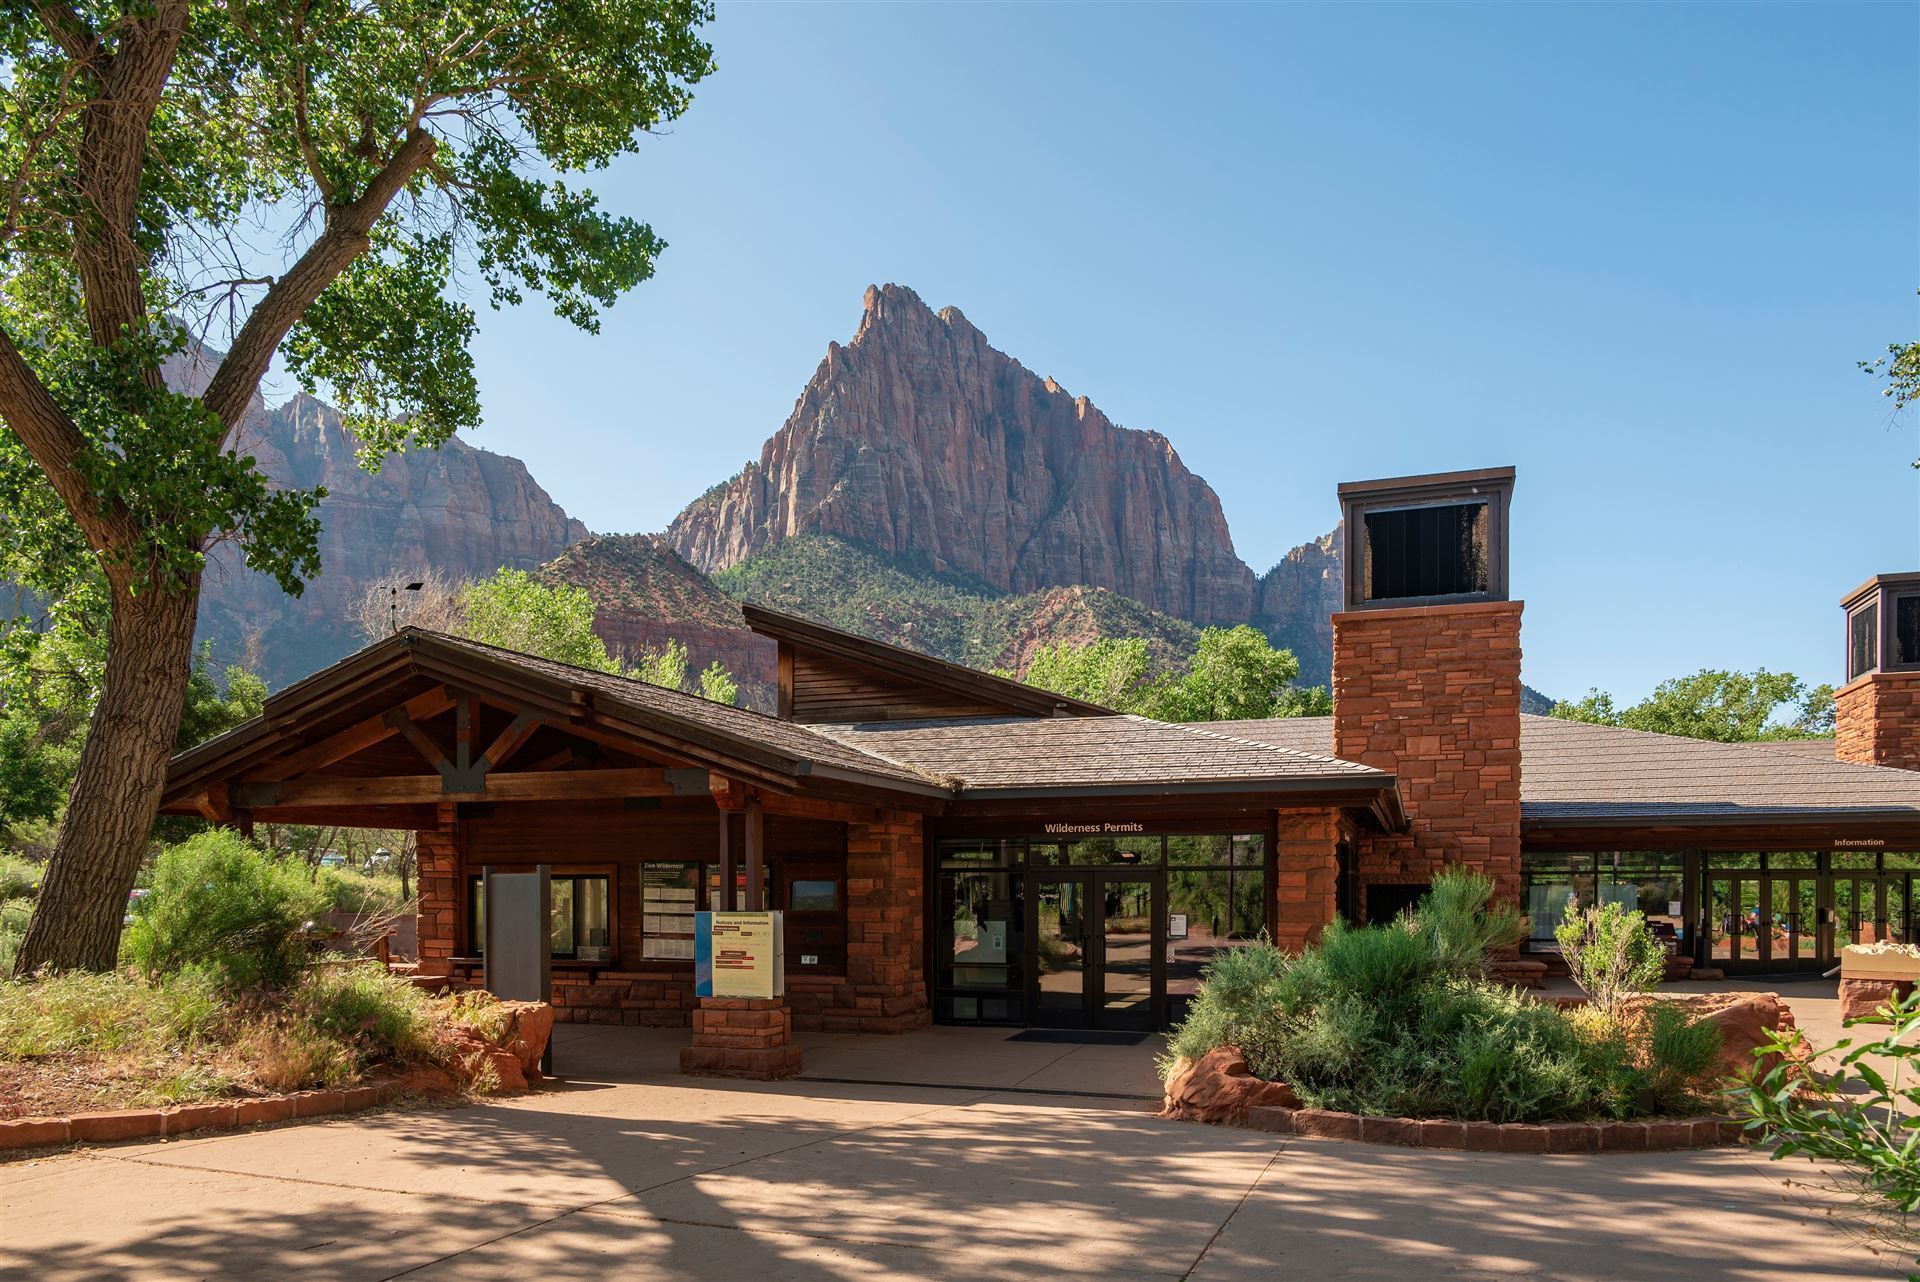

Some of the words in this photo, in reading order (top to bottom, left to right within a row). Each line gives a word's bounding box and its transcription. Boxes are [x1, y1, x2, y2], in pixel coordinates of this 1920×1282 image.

[1044, 823, 1101, 833] Wilderness
[1104, 822, 1144, 832] Permits
[1834, 838, 1885, 846] Information
